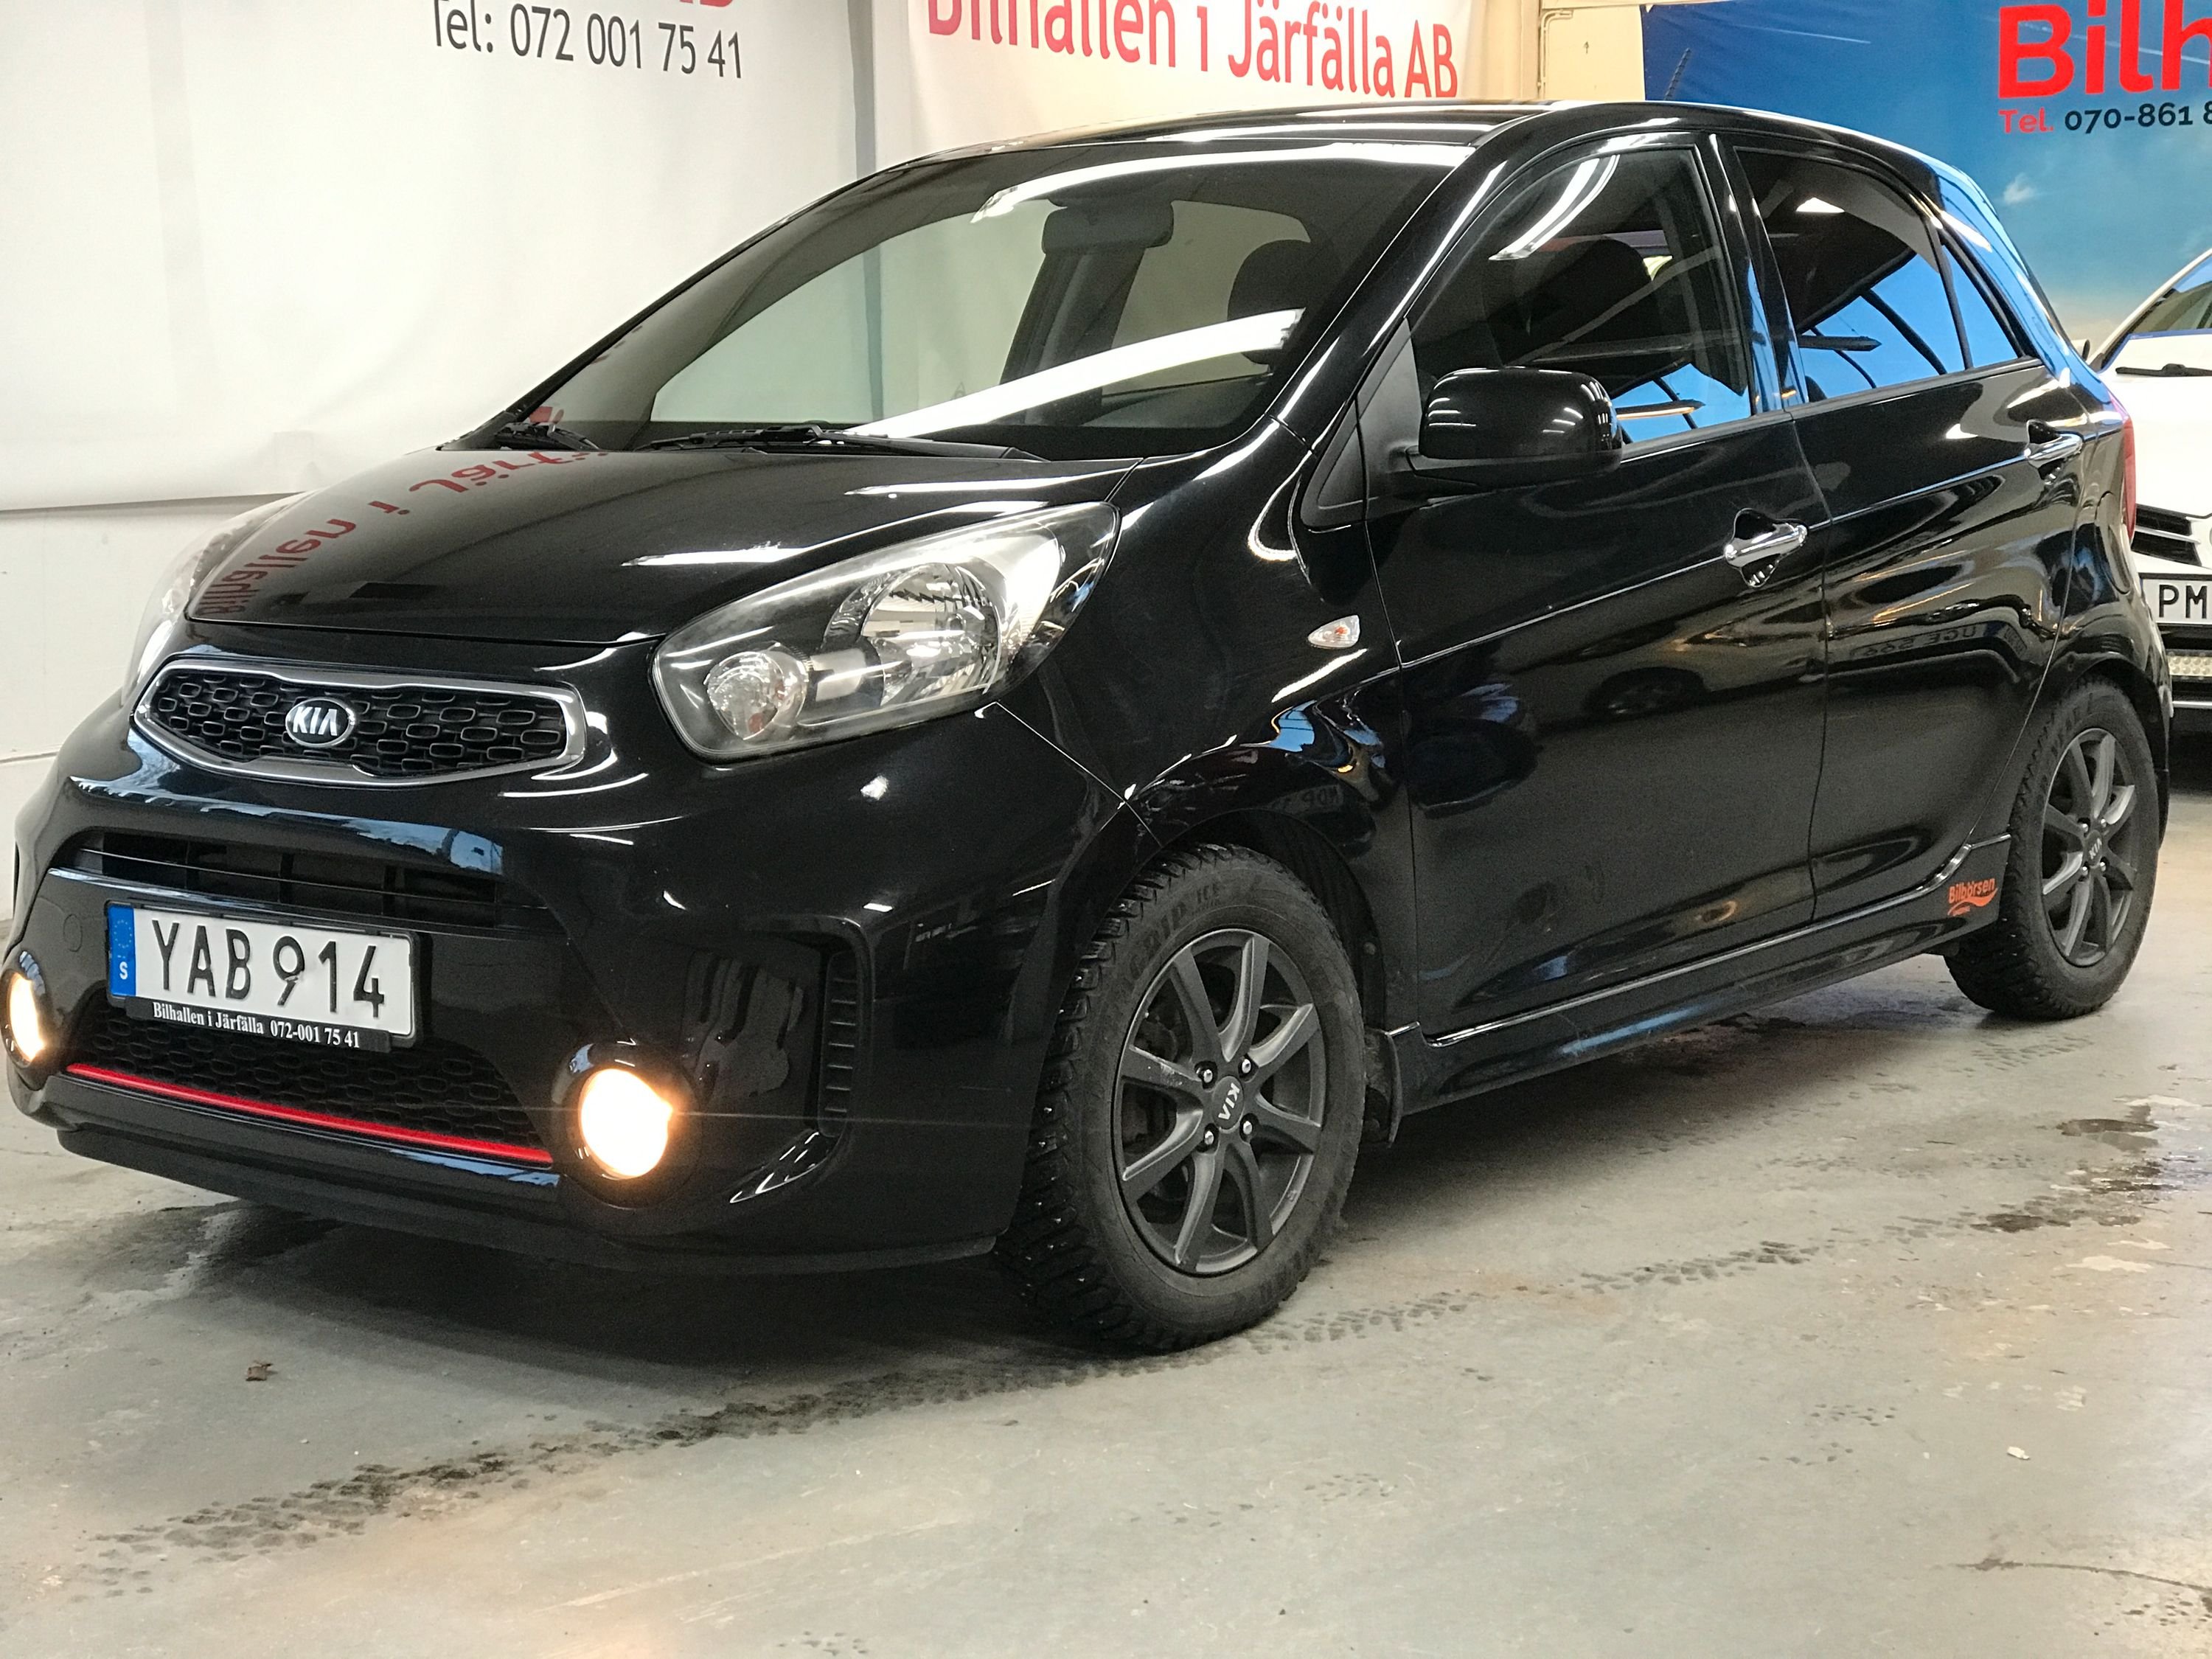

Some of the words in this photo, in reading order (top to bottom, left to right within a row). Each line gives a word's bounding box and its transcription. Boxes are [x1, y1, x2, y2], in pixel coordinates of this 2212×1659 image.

[510, 3, 574, 62] 072
[587, 13, 641, 69] 001
[658, 21, 696, 74] 75
[707, 29, 741, 79] 41
[1228, 0, 1396, 98] Järfälla
[1404, 19, 1458, 98] AB
[1997, 107, 2053, 134] Tel.
[2065, 102, 2194, 134] 070-861
[2159, 584, 2208, 619] PM
[292, 706, 338, 737] KIA
[119, 961, 128, 980] S
[152, 919, 251, 1001] YAB
[272, 935, 385, 1019] 914
[152, 1001, 205, 1026] Bilhallen
[207, 1012, 212, 1027] i
[215, 1012, 264, 1034] Järfälla
[270, 1020, 320, 1043] 072-001
[324, 1027, 341, 1046] 75
[344, 1031, 360, 1048] 41
[1217, 1082, 1240, 1120] KIA
